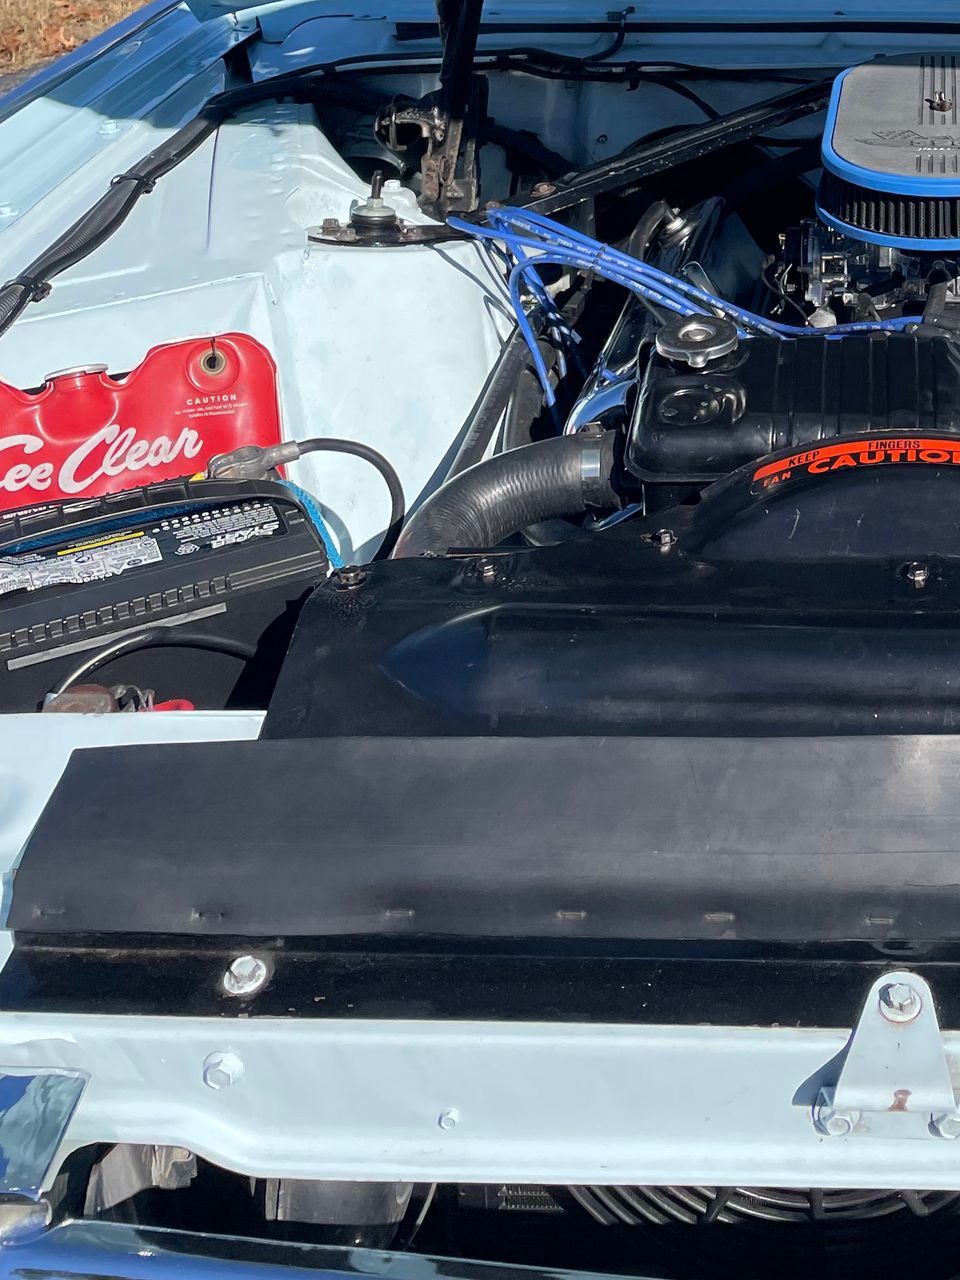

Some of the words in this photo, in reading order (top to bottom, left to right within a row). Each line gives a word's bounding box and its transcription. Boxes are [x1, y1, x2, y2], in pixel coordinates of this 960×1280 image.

[186, 393, 237, 406] CAUTION
[58, 424, 204, 494] Clear
[787, 450, 820, 468] KEEP
[868, 440, 920, 452] FINGERS
[763, 471, 791, 487] FAN
